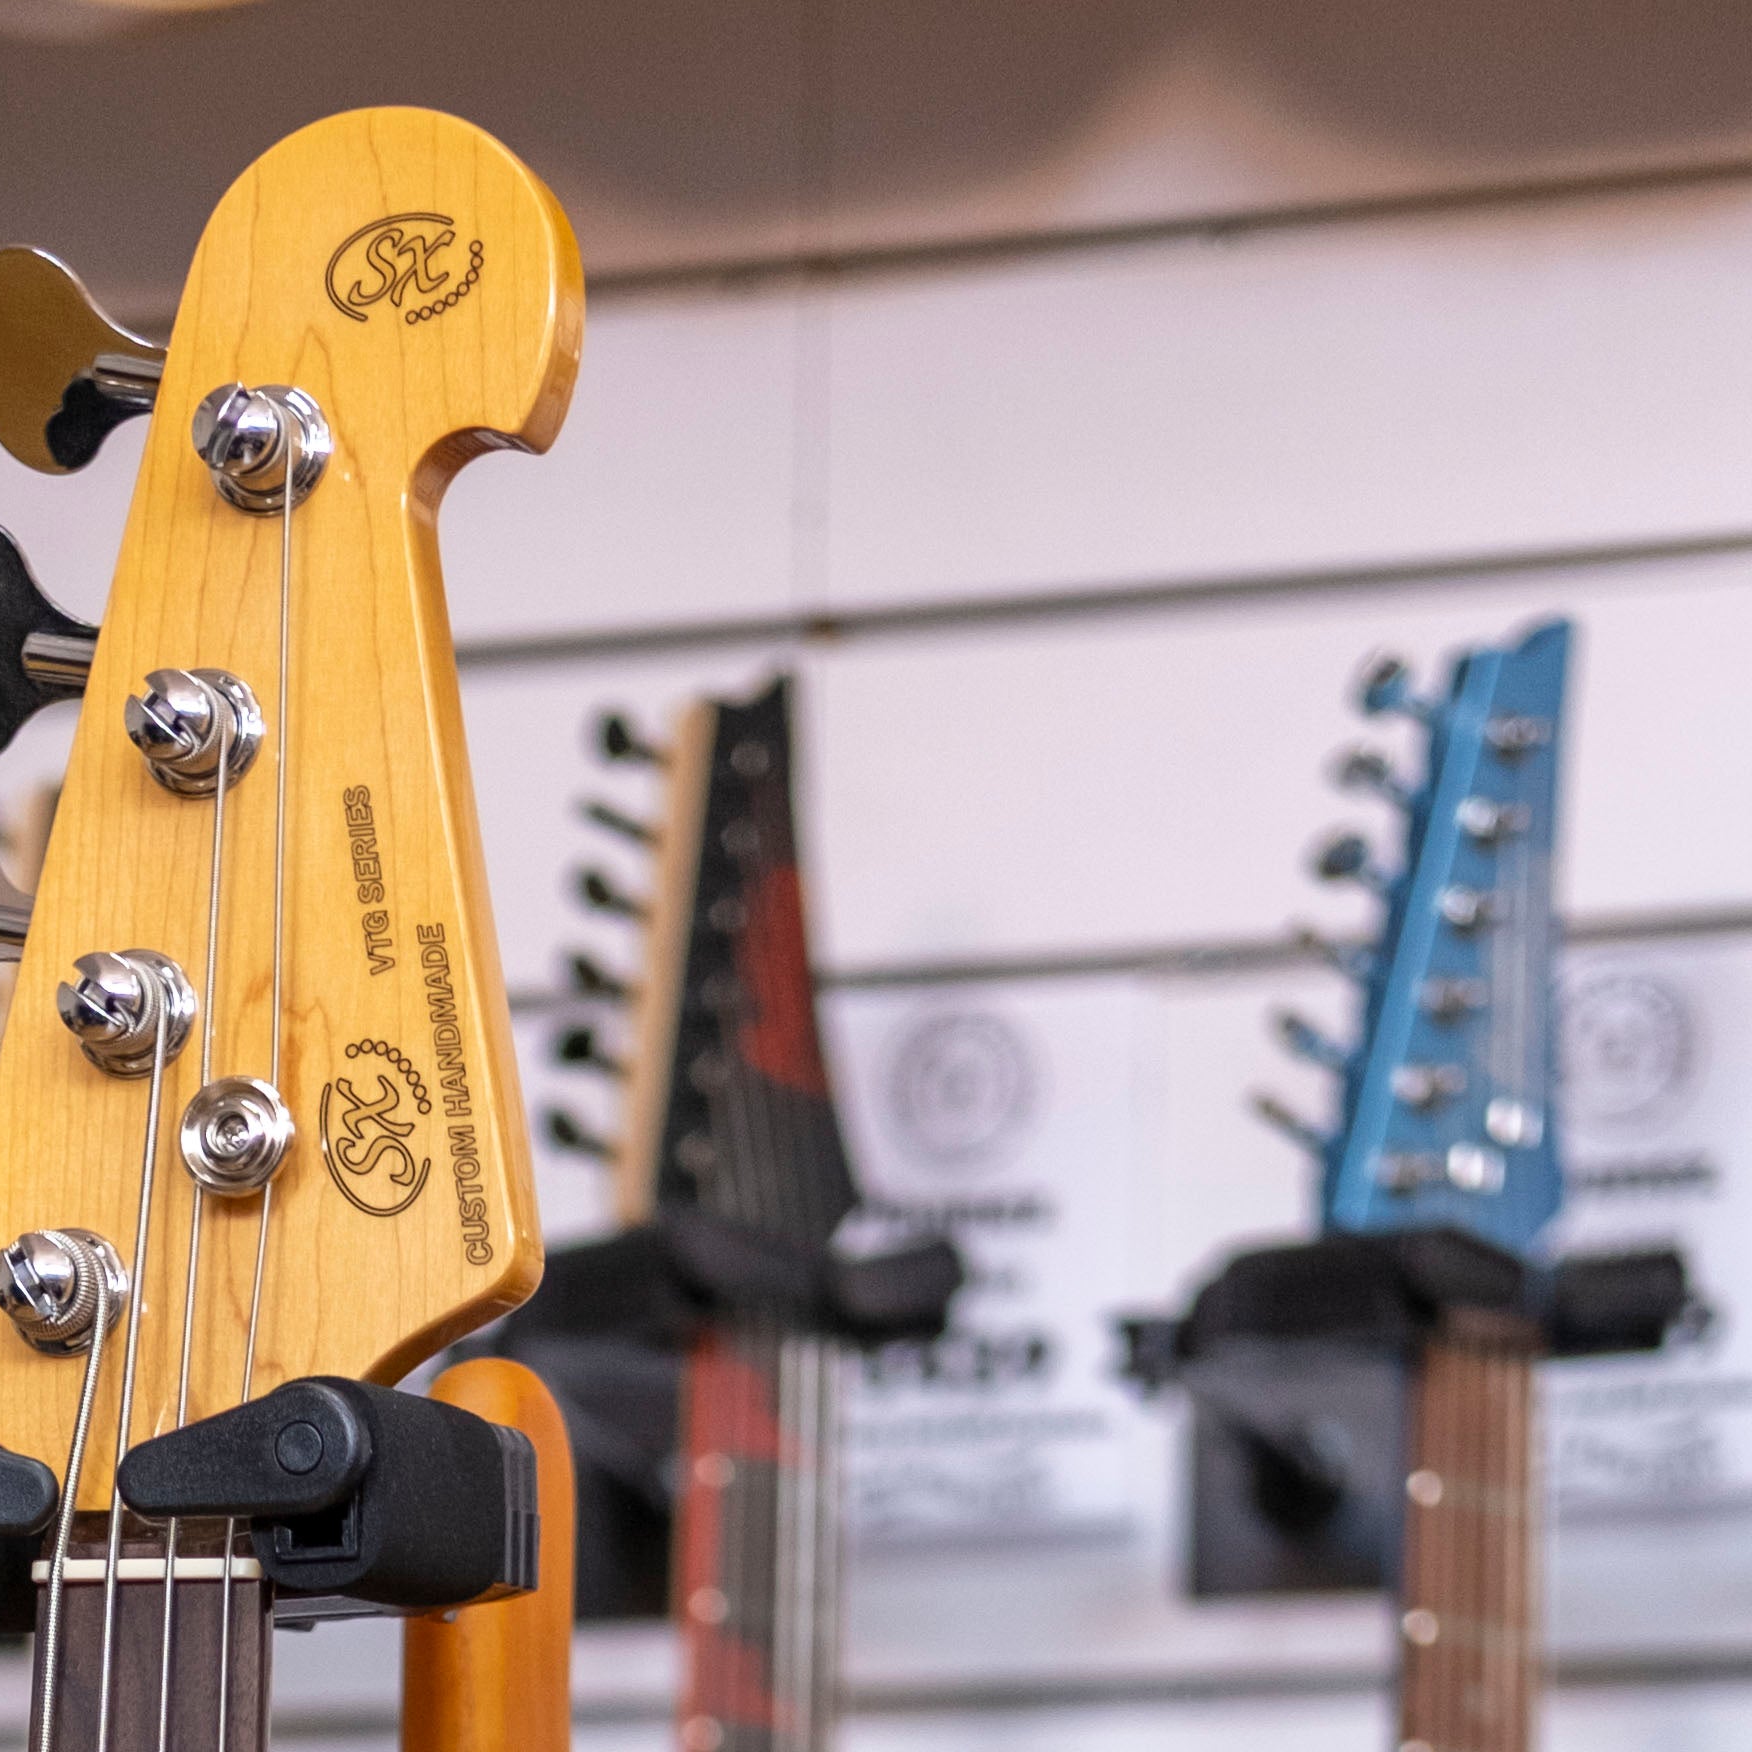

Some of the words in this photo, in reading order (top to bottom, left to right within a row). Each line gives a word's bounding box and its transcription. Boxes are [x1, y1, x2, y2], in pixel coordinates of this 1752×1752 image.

[348, 228, 456, 307] SX
[342, 783, 385, 905] SERIES
[361, 909, 396, 977] VTG
[416, 921, 473, 1118] HANDMADE
[336, 1072, 416, 1188] SX
[446, 1125, 494, 1267] CUSTOM
